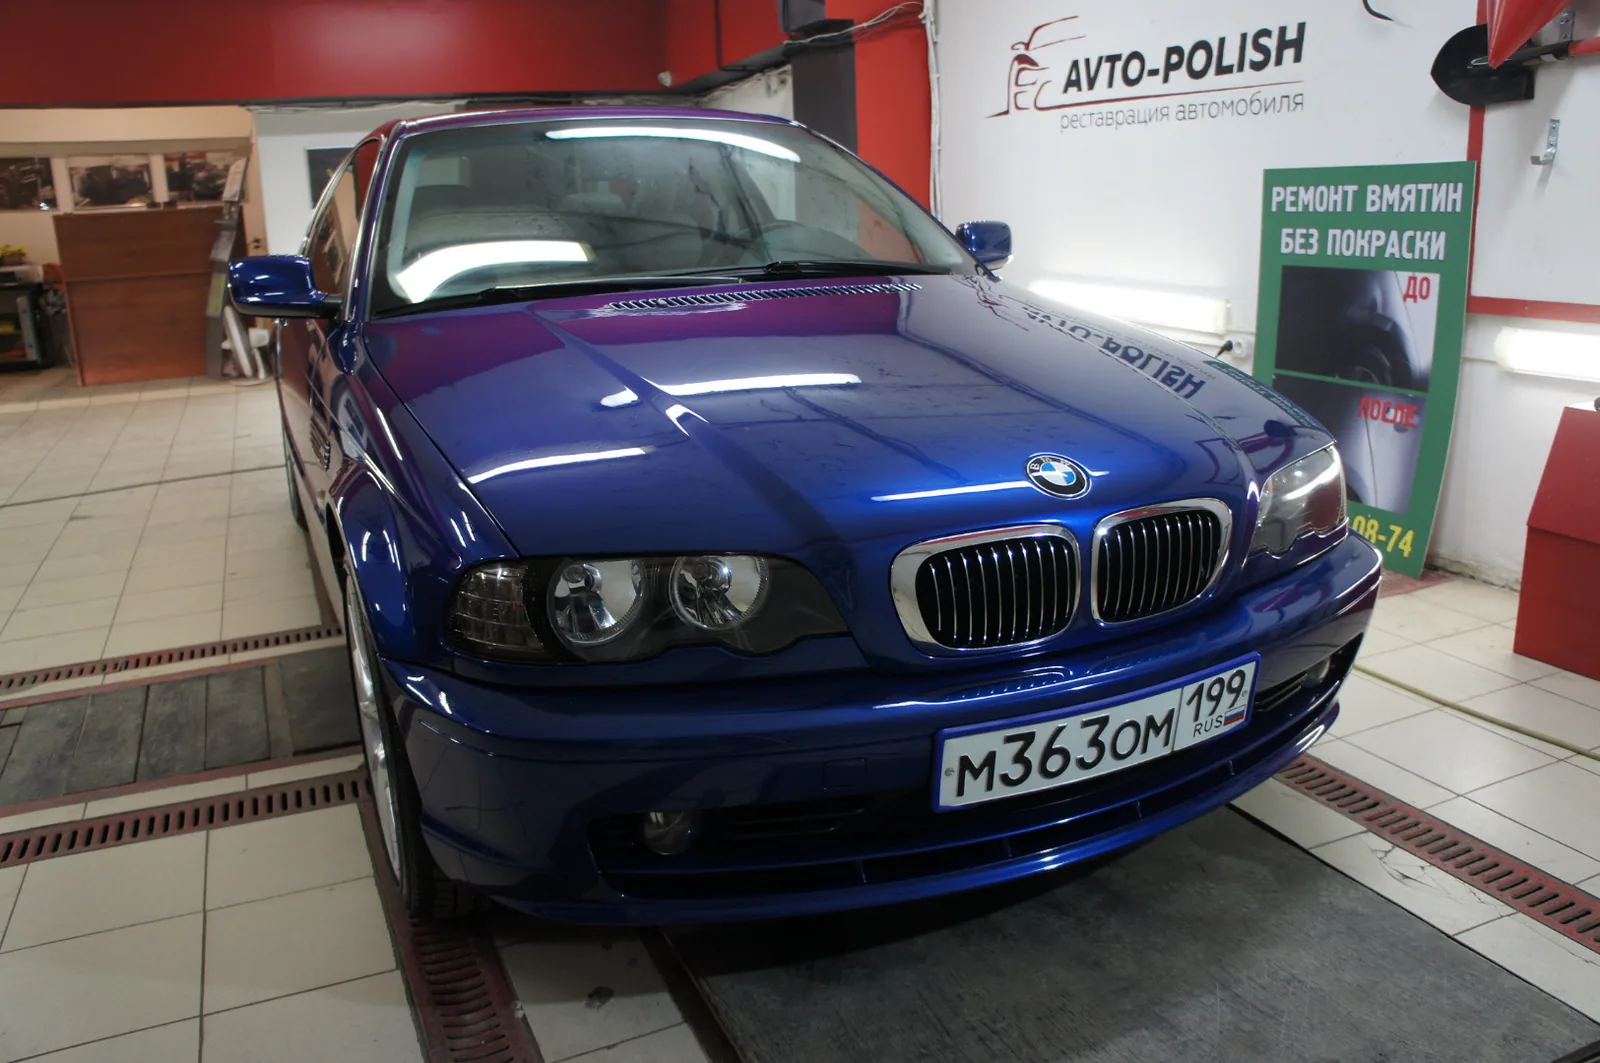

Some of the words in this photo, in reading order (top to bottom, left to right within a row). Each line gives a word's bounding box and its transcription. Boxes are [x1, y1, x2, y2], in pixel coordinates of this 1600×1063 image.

[1062, 22, 1307, 94] AVTO-POLISH
[1060, 104, 1170, 133] реставрация
[1175, 90, 1305, 122] автомобиля
[1271, 185, 1359, 213] РЕМОНТ
[1365, 182, 1464, 213] ВМЯТИН
[1280, 228, 1319, 255] БЕЗ
[1326, 229, 1447, 261] ПОКРАСКИ
[1403, 275, 1431, 303] ДО
[1358, 396, 1419, 428] ПОСЛЕ
[1186, 669, 1246, 723] 199
[1193, 715, 1223, 737] RUS
